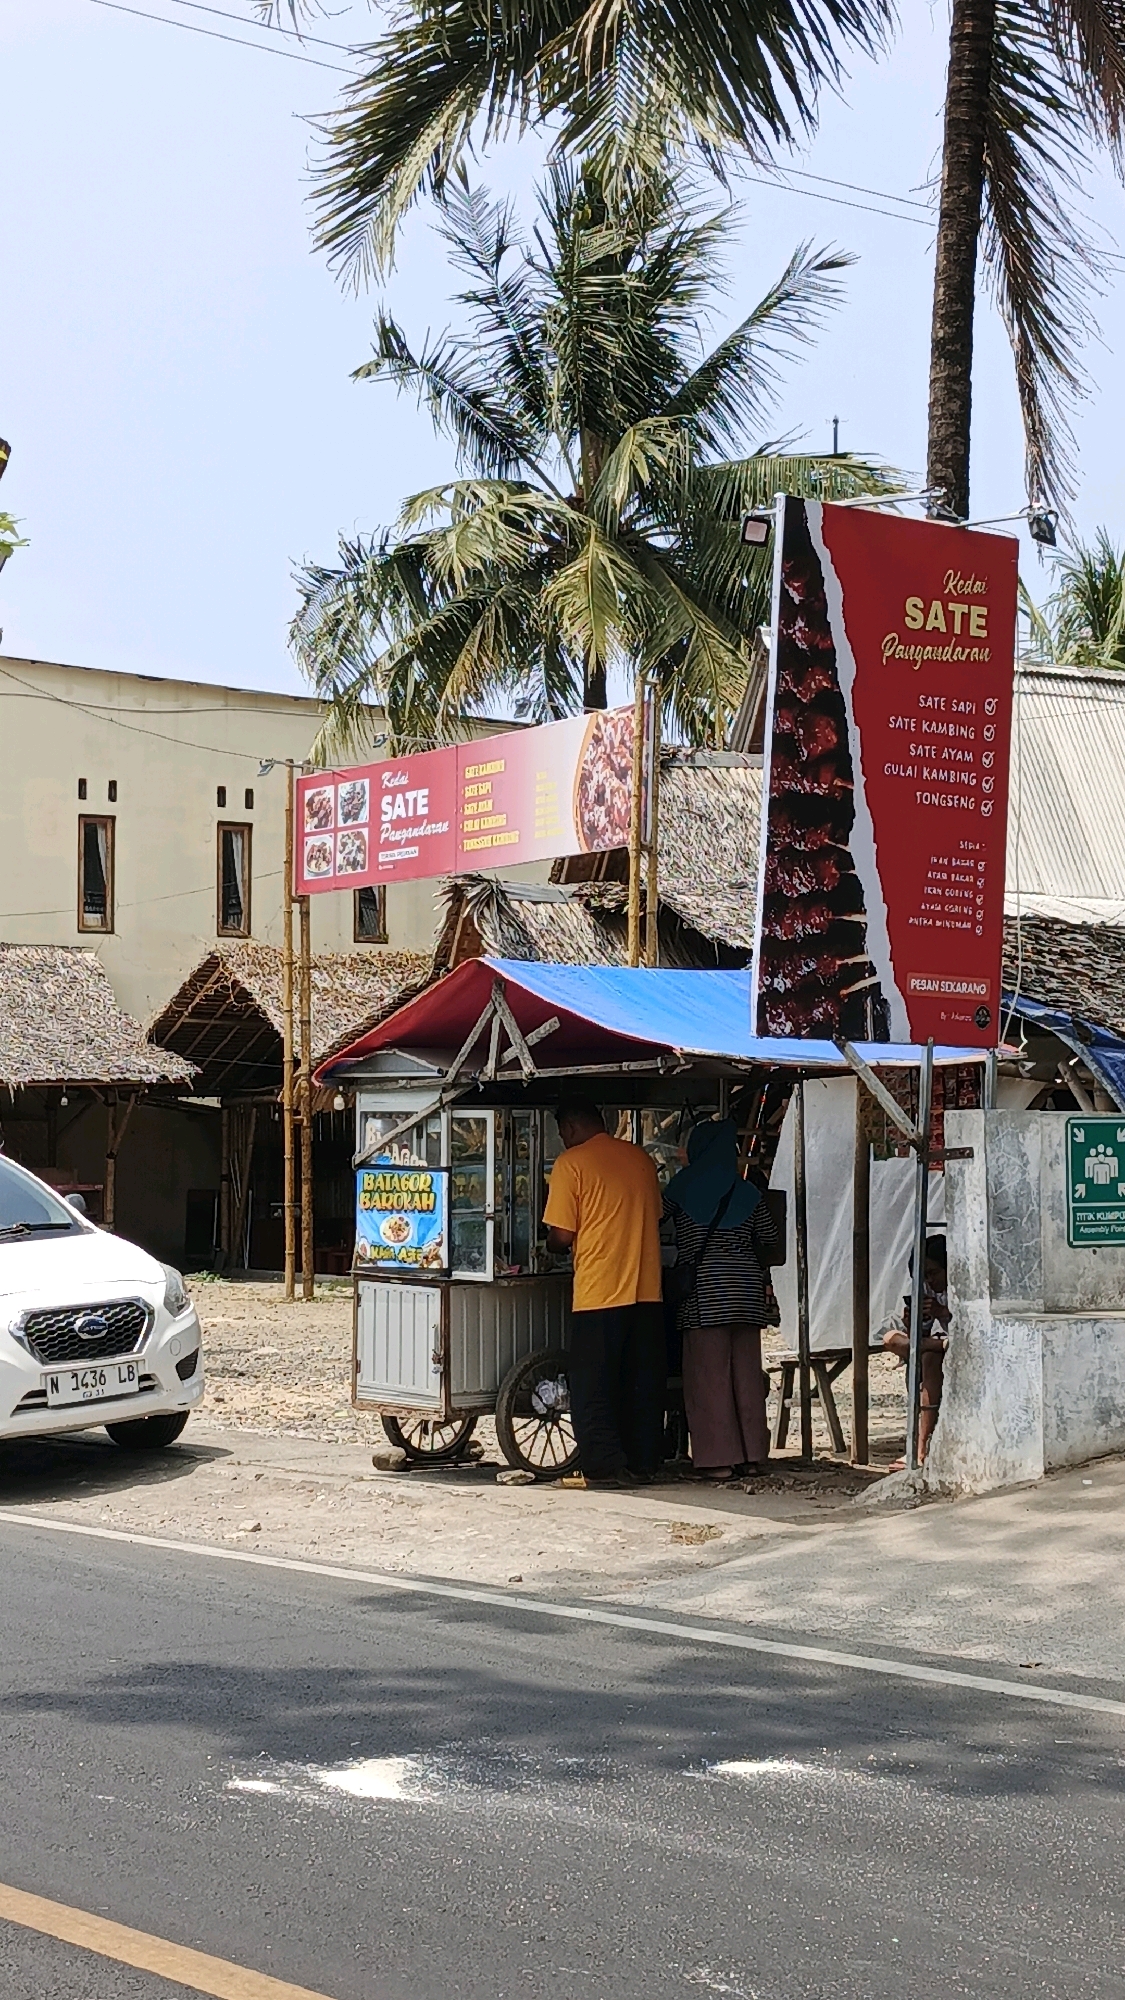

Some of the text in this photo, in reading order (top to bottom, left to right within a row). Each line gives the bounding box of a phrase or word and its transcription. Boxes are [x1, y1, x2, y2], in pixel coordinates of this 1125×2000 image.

[943, 569, 988, 597] Kedai
[904, 596, 988, 639] SATE
[881, 632, 993, 671] Pangandaran
[918, 694, 976, 715] SATE SAPI
[888, 715, 976, 740] SATE KAMBING
[909, 743, 974, 763] SATE AYAM
[381, 769, 409, 789] Kedai
[884, 762, 977, 786] GULAI KAMBING
[380, 787, 429, 822] SATE
[915, 791, 976, 810] TONGSENG
[910, 978, 987, 995] PESAN SEKARANG
[362, 1172, 433, 1193] BATAGOR
[359, 1191, 436, 1211] BAROKAH
[50, 1364, 136, 1395] N 1436 LB
